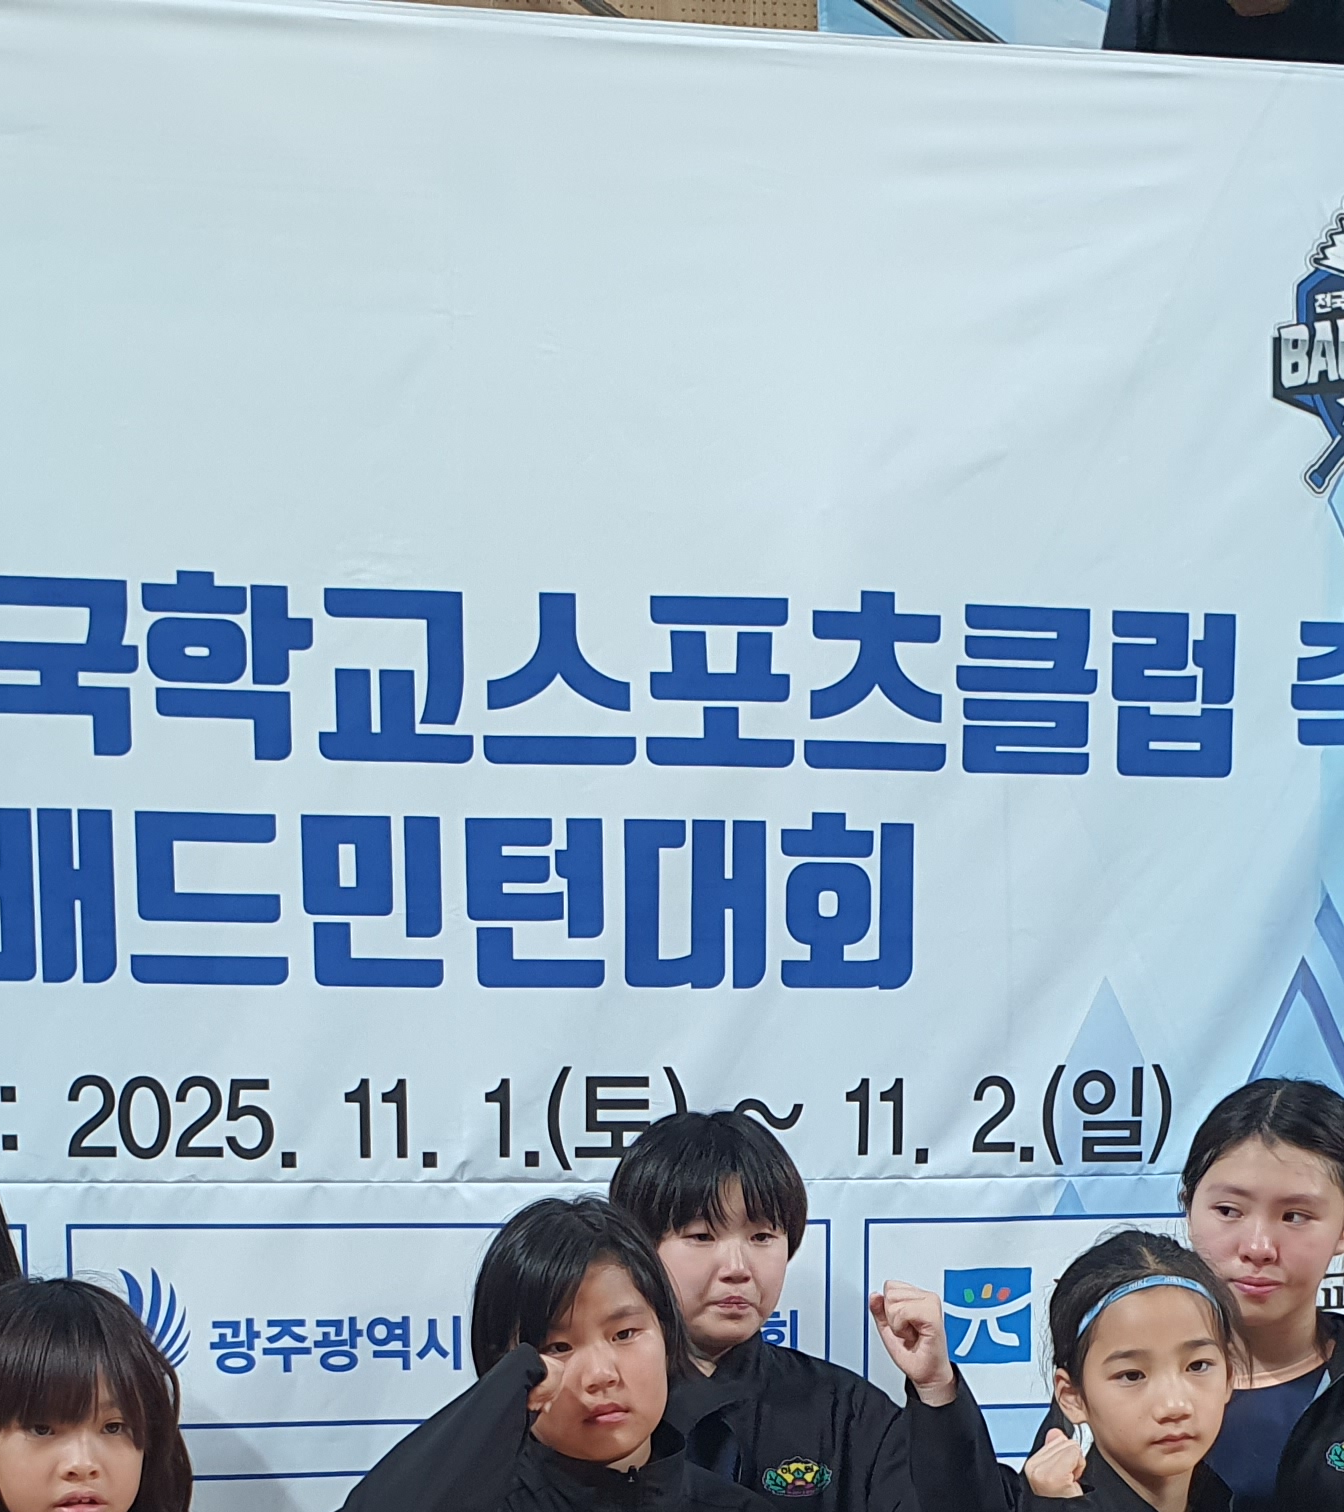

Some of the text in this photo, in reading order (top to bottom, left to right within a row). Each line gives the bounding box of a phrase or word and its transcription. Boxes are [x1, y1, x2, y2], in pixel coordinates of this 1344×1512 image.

[67, 1075, 297, 1168] 2025.
[344, 1078, 438, 1168] 11.
[845, 1078, 929, 1164] 11.
[972, 1064, 1173, 1165] 2.(일)
[209, 1315, 462, 1374] 광주광역시
